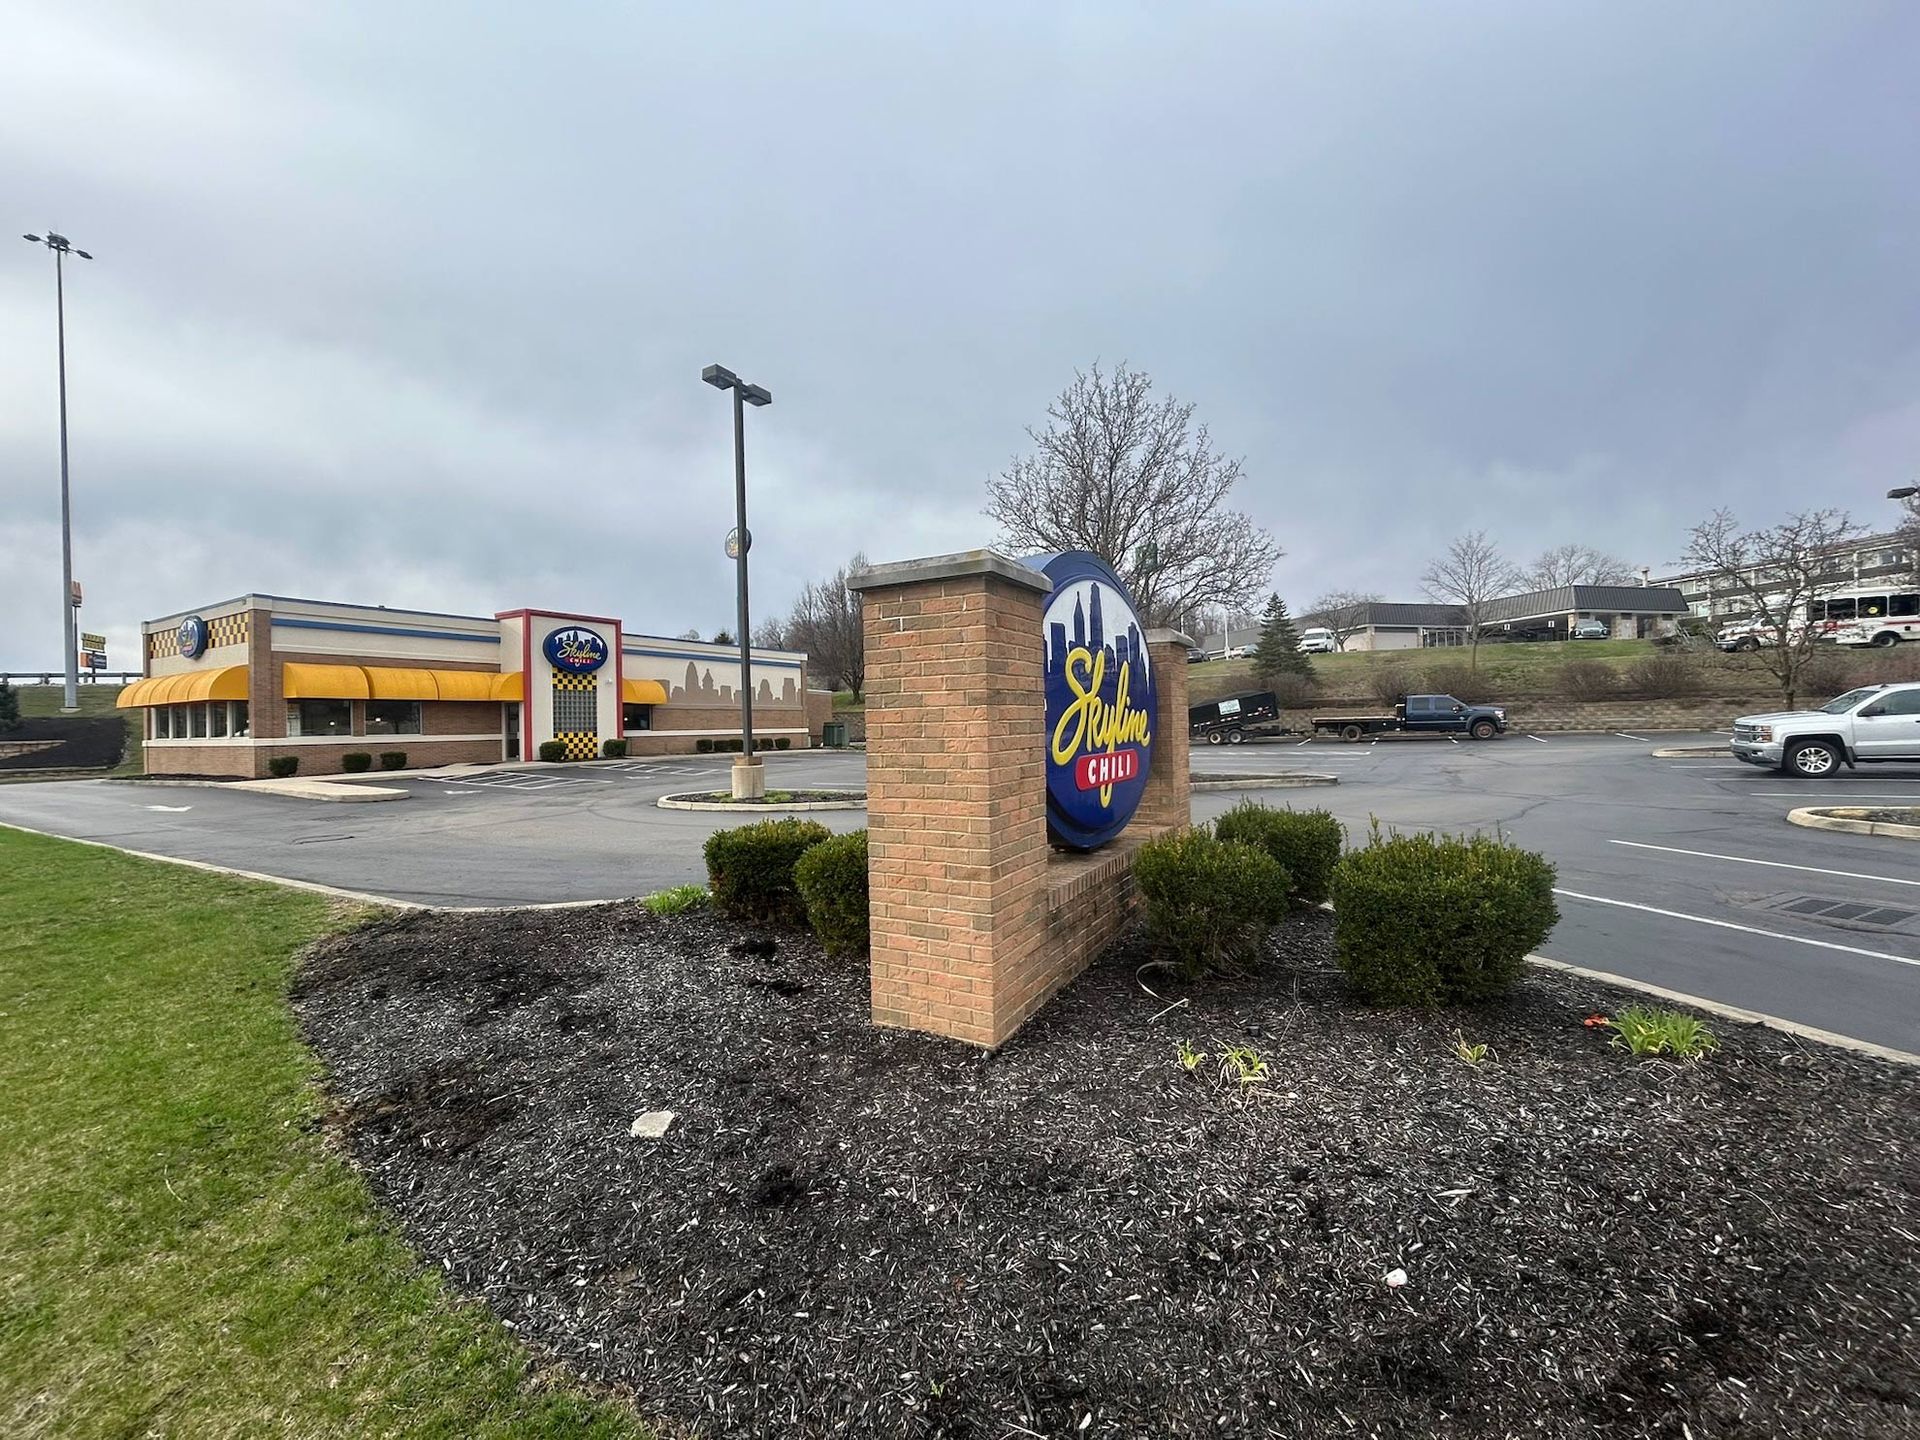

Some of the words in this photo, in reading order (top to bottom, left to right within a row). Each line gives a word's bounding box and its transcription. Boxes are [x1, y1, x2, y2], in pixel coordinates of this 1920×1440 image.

[557, 641, 602, 667] Skyline
[1052, 647, 1150, 808] Skyline
[1088, 754, 1131, 784] CHILI
